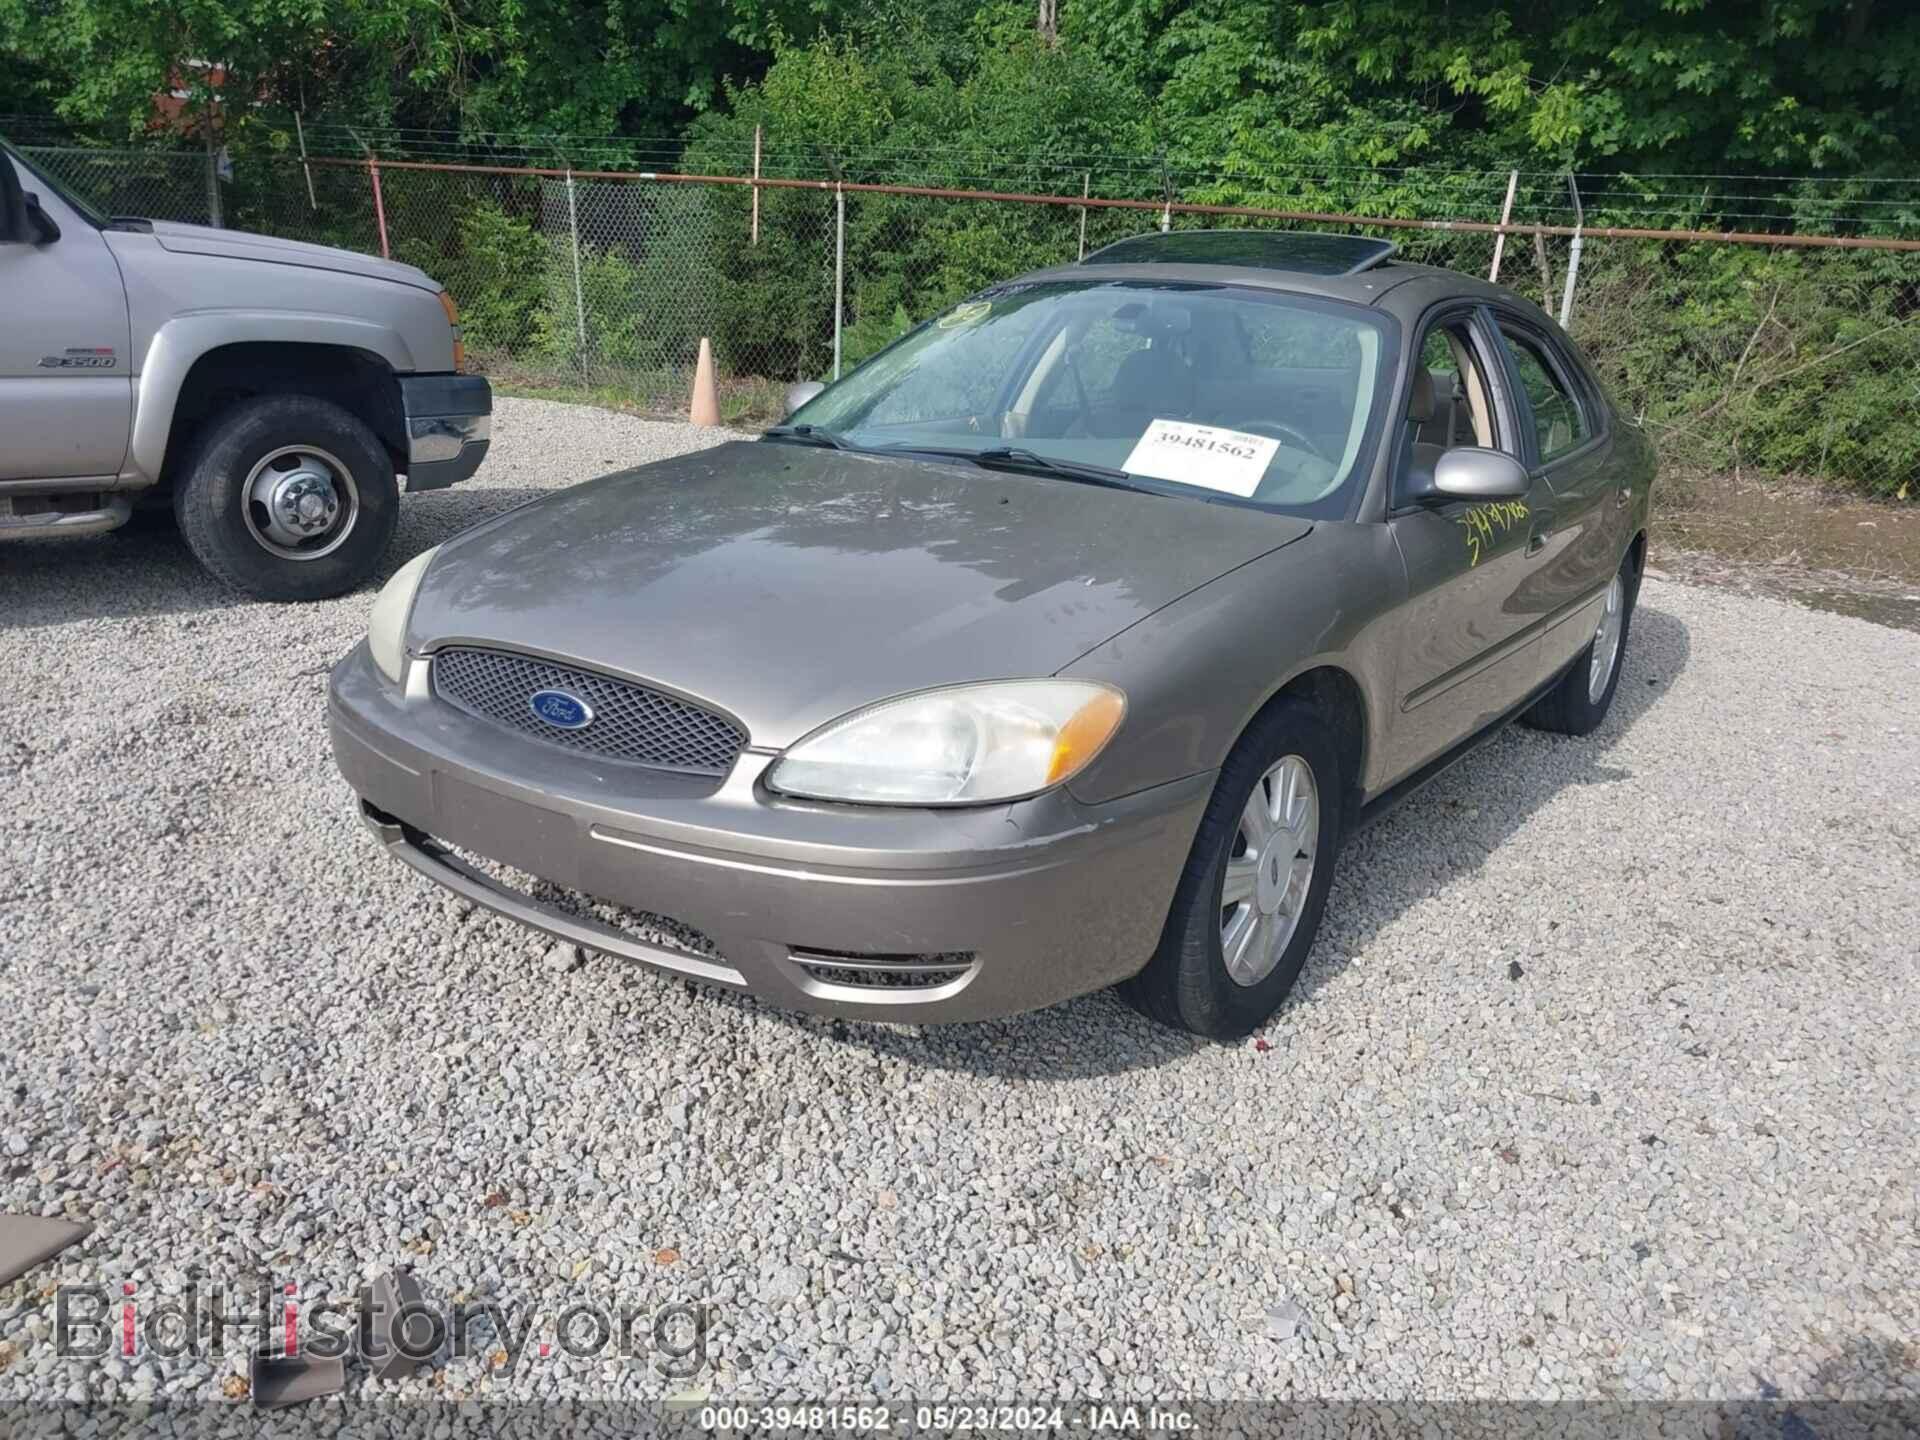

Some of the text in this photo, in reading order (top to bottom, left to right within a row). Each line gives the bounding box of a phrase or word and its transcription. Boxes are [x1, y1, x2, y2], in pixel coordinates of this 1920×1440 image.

[61, 356, 117, 368] 3500
[1156, 431, 1256, 460] 39481562
[542, 697, 577, 720] Ford
